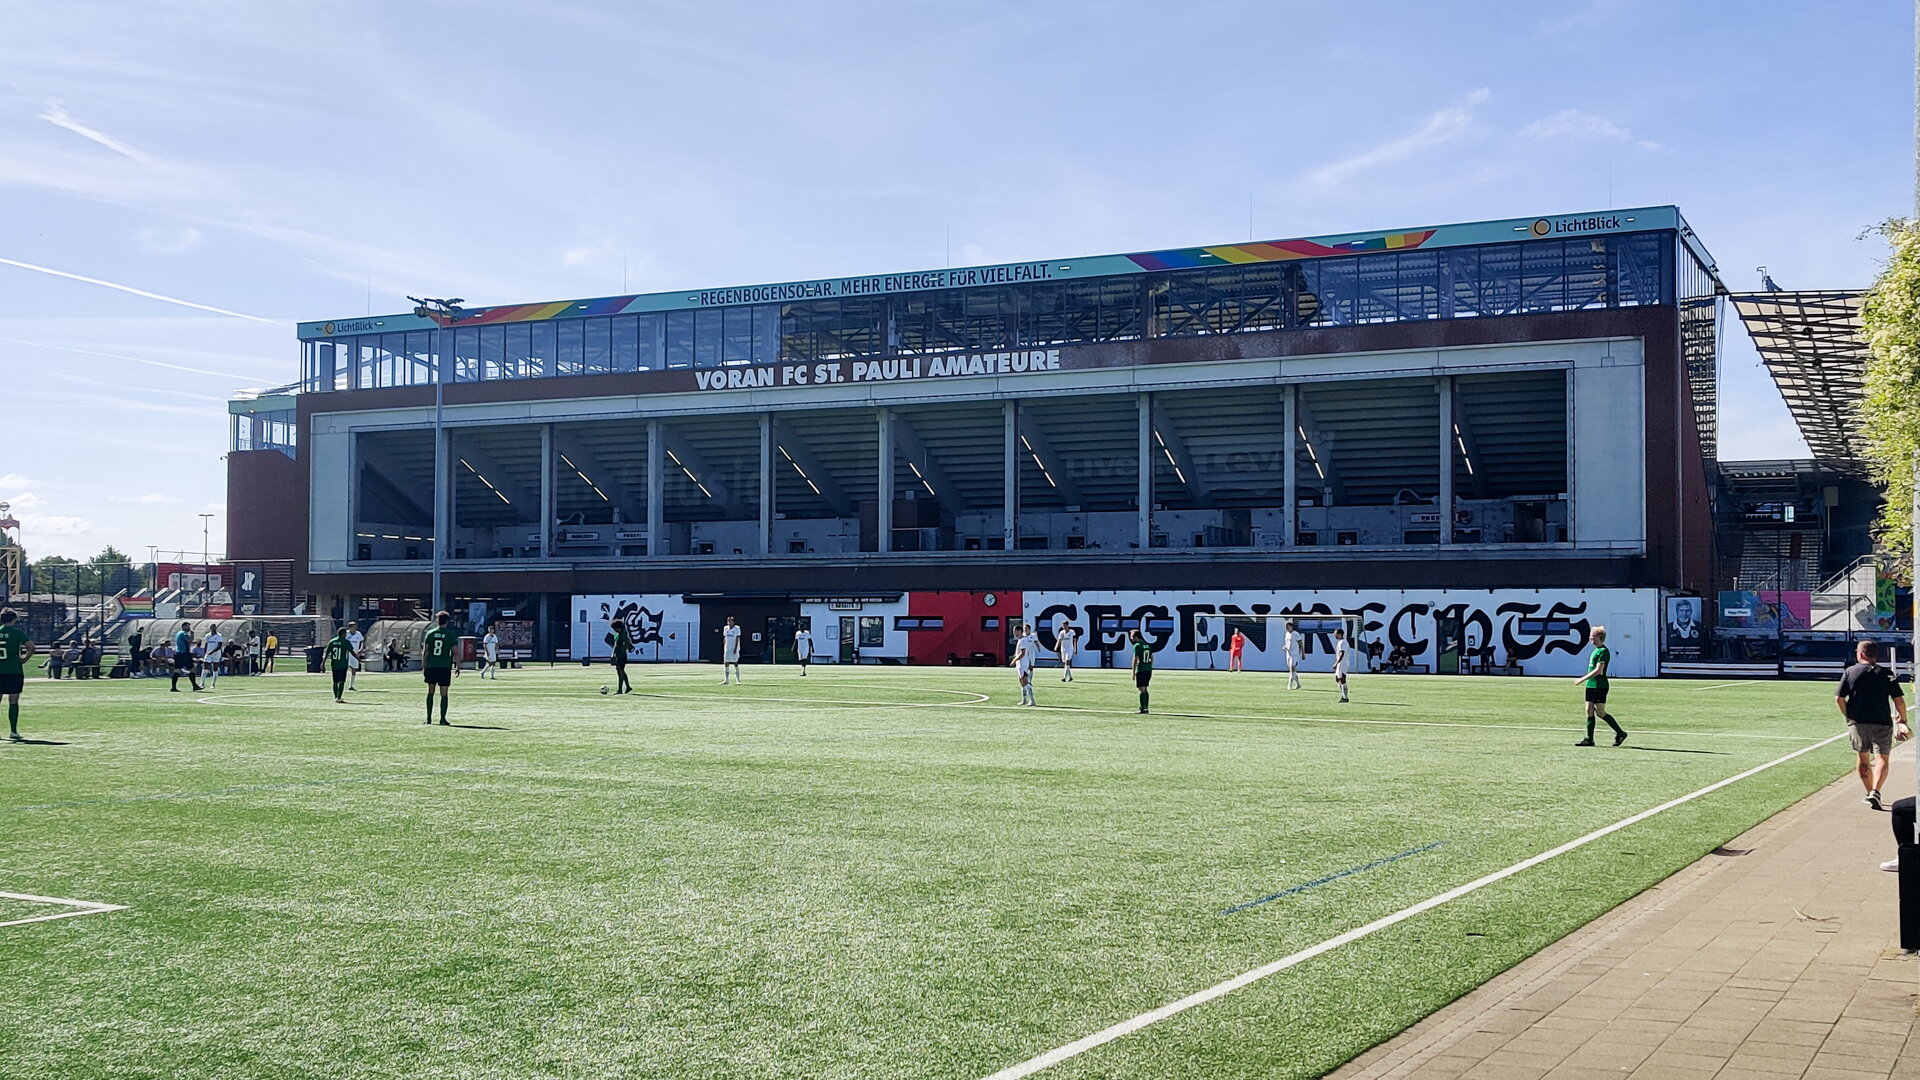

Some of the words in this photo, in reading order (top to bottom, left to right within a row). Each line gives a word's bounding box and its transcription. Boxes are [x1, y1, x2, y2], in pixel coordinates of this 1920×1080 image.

[1555, 216, 1621, 233] LichtBlick
[701, 282, 837, 306] REGENBOGENSOLAR.
[841, 278, 881, 295] MEHR
[885, 273, 945, 291] ENERGIE
[950, 269, 977, 286] FÜR
[980, 263, 1052, 283] VIELFALT.
[337, 321, 374, 333] LichtBlick
[695, 367, 775, 390] VORAN
[782, 364, 808, 385] FC
[814, 363, 845, 384] ST.
[852, 356, 921, 381] PAULI
[927, 349, 1060, 377] AMATEURE
[1036, 604, 1272, 653] GEGEN
[1280, 601, 1591, 660] RECHTS
[332, 647, 342, 661] 31
[433, 640, 443, 656] 8
